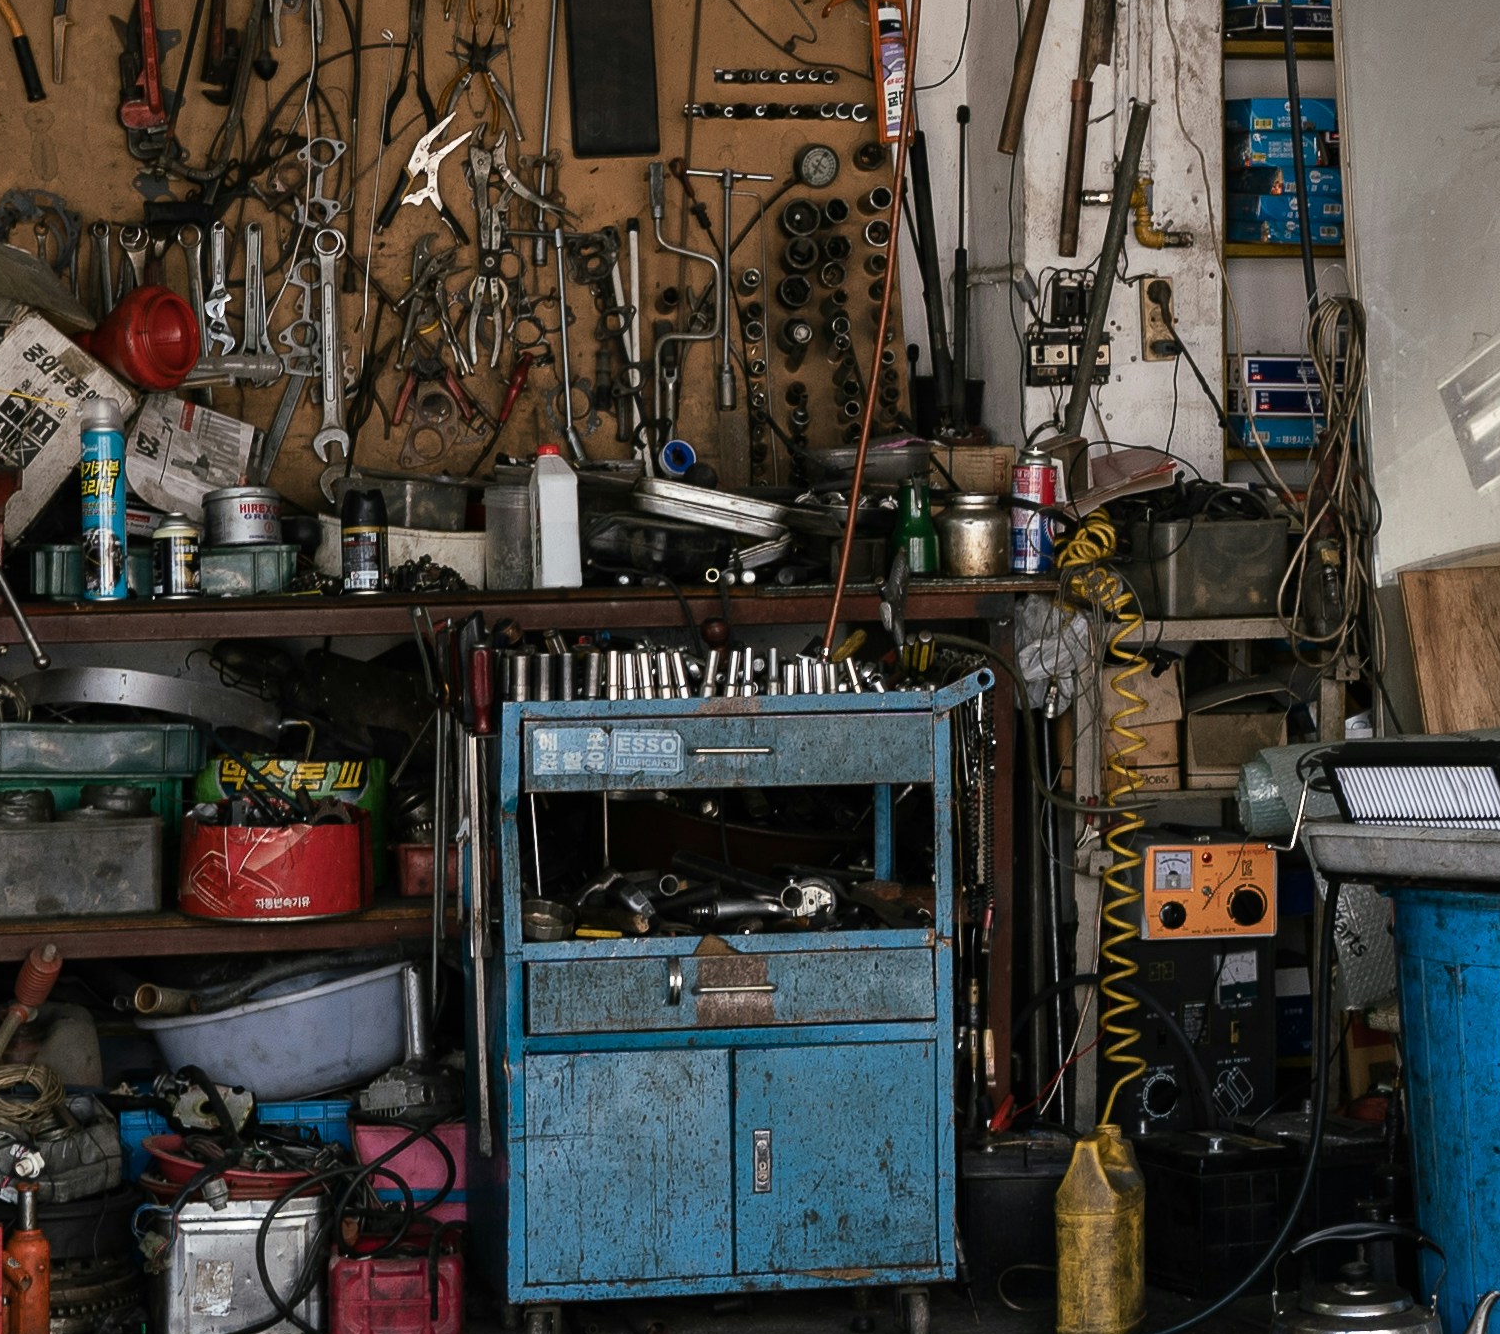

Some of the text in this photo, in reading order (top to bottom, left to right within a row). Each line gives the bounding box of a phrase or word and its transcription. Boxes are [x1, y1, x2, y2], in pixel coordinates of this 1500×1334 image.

[239, 502, 272, 515] HIREX
[617, 736, 678, 755] ESSO
[254, 895, 311, 910] 자동변속기유
